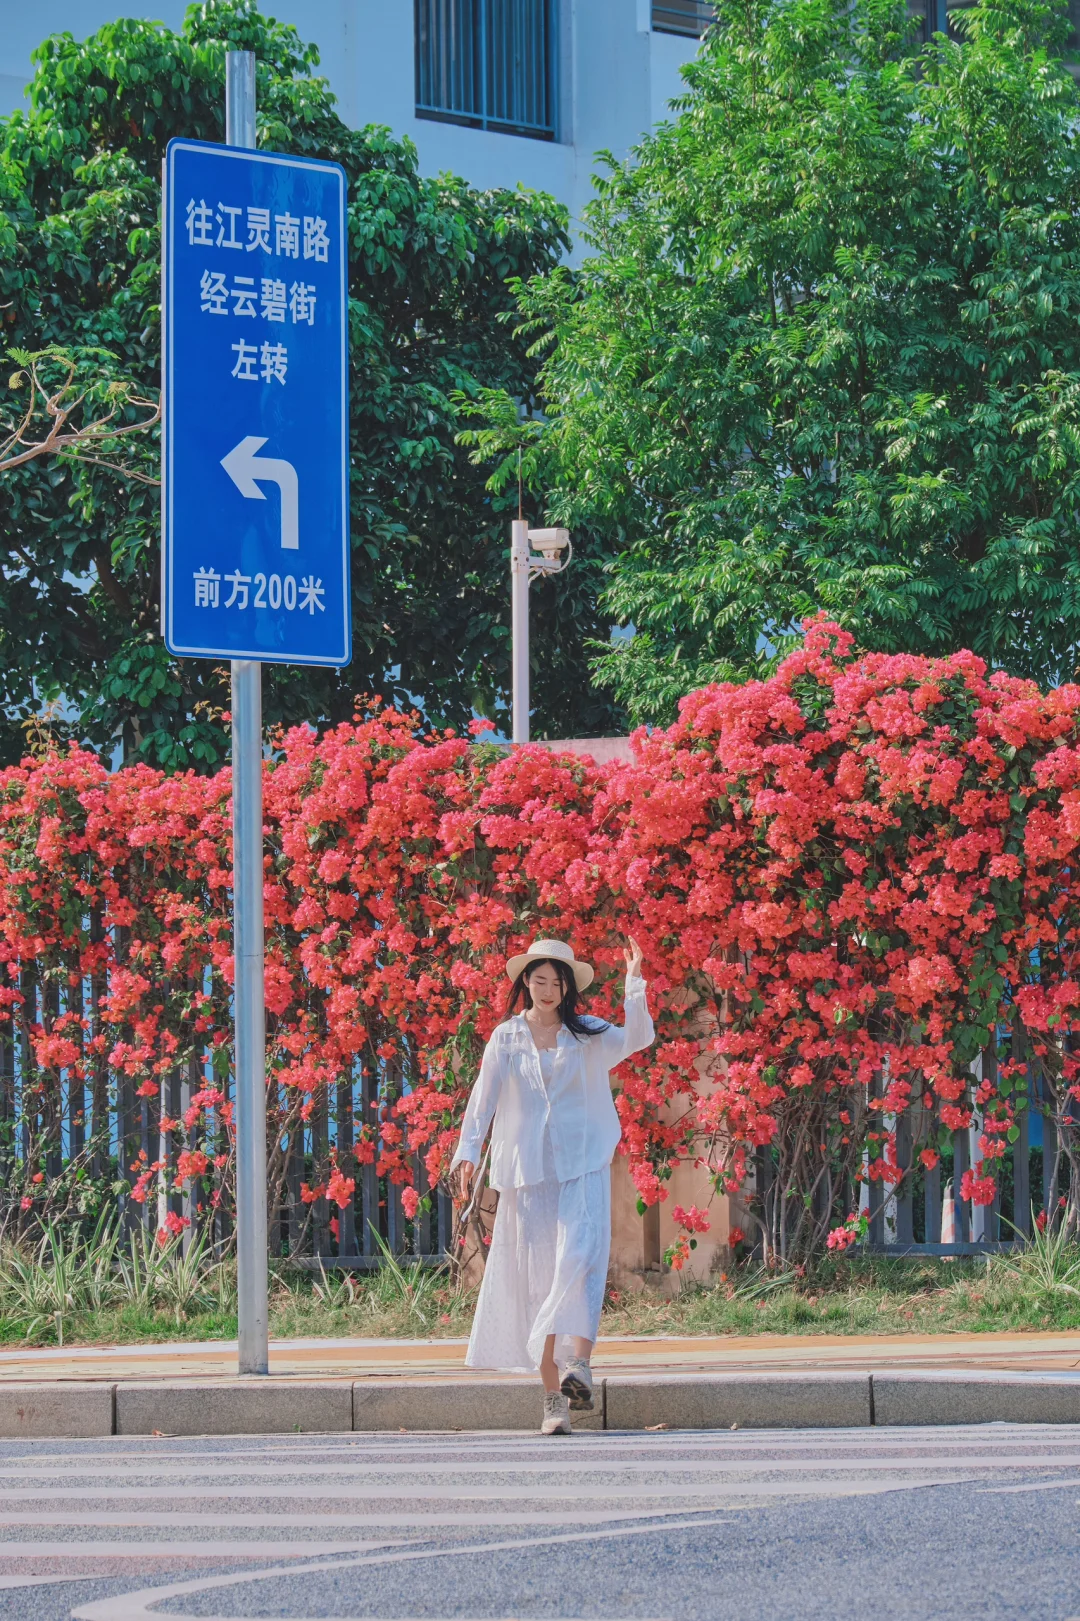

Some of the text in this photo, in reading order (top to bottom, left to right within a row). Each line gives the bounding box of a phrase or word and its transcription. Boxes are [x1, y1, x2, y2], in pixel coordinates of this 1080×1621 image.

[185, 198, 330, 263] 往江灵南路
[200, 269, 316, 326] 经云碧街
[231, 338, 288, 386] 左转
[193, 566, 326, 615] 前方200米
